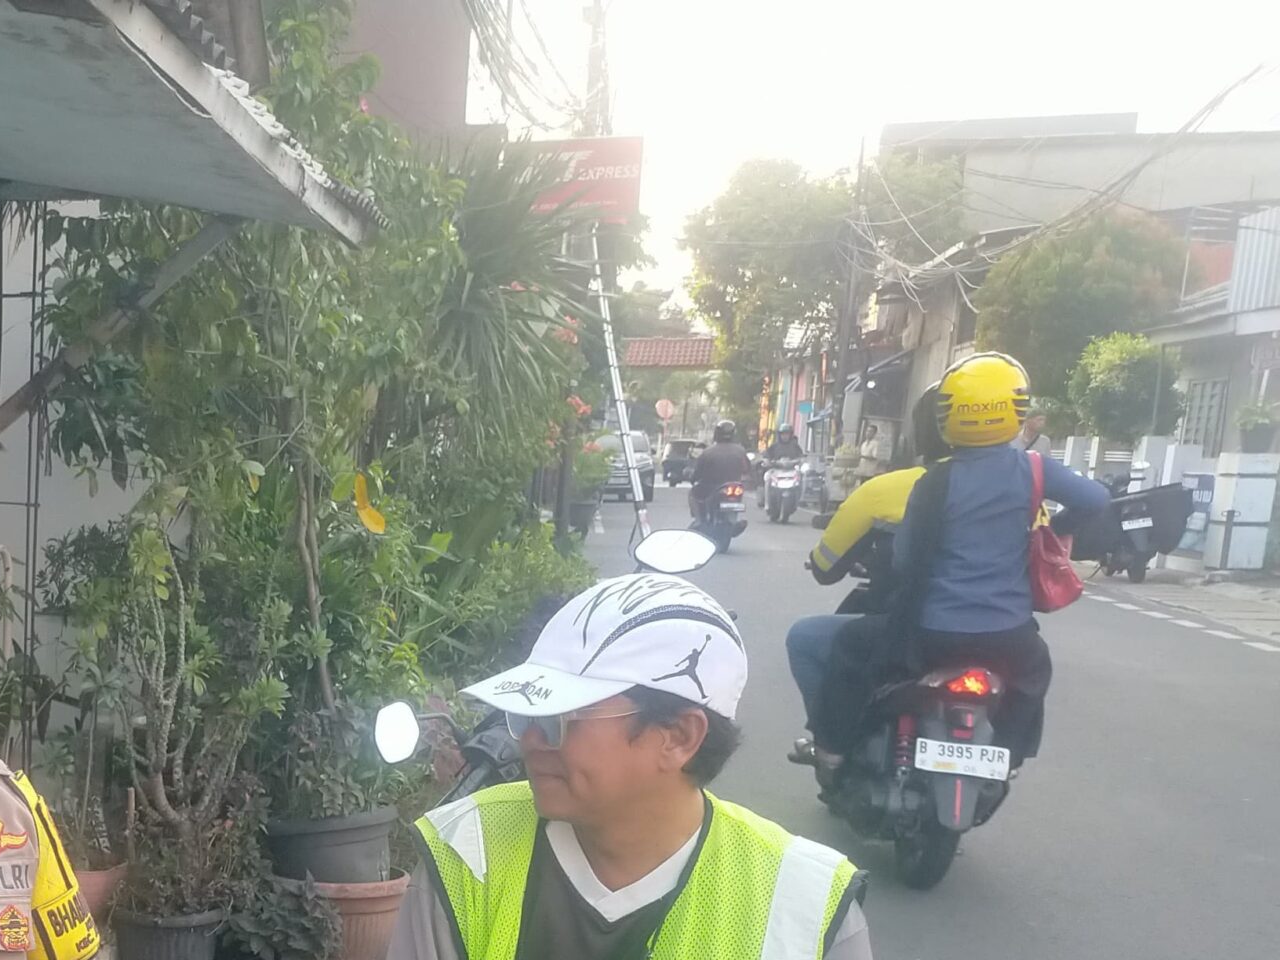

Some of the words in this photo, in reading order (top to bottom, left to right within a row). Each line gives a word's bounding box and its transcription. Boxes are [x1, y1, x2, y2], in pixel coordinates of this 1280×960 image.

[578, 164, 640, 181] EXPRESS
[957, 398, 1008, 414] maxim
[919, 740, 928, 754] B
[938, 744, 973, 760] 3995
[979, 748, 1006, 763] PJR
